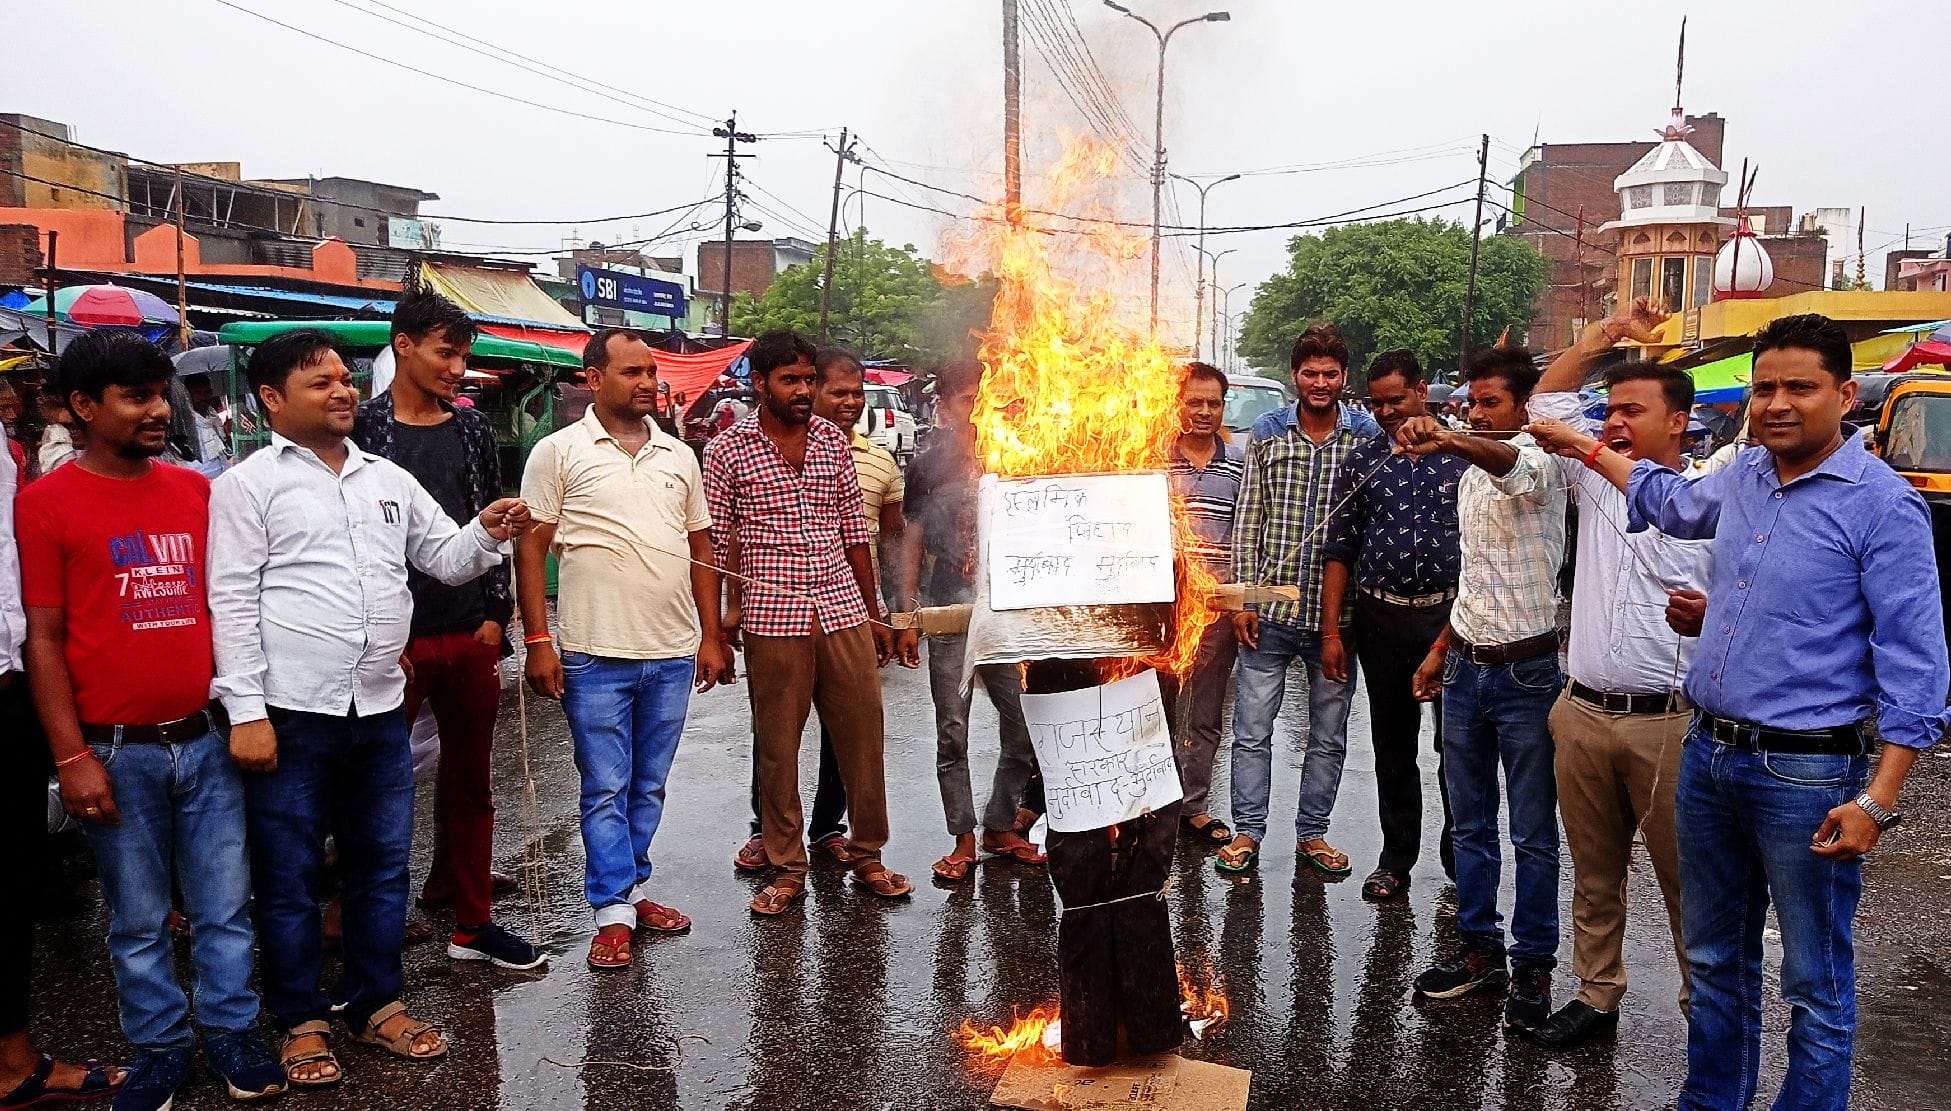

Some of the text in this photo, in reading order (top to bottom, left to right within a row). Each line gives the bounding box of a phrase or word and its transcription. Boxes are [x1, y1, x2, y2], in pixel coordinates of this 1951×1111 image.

[597, 277, 617, 301] SBI
[133, 566, 182, 577] KLEIN
[114, 572, 129, 597] 7
[121, 604, 201, 622] AUTHENTIC
